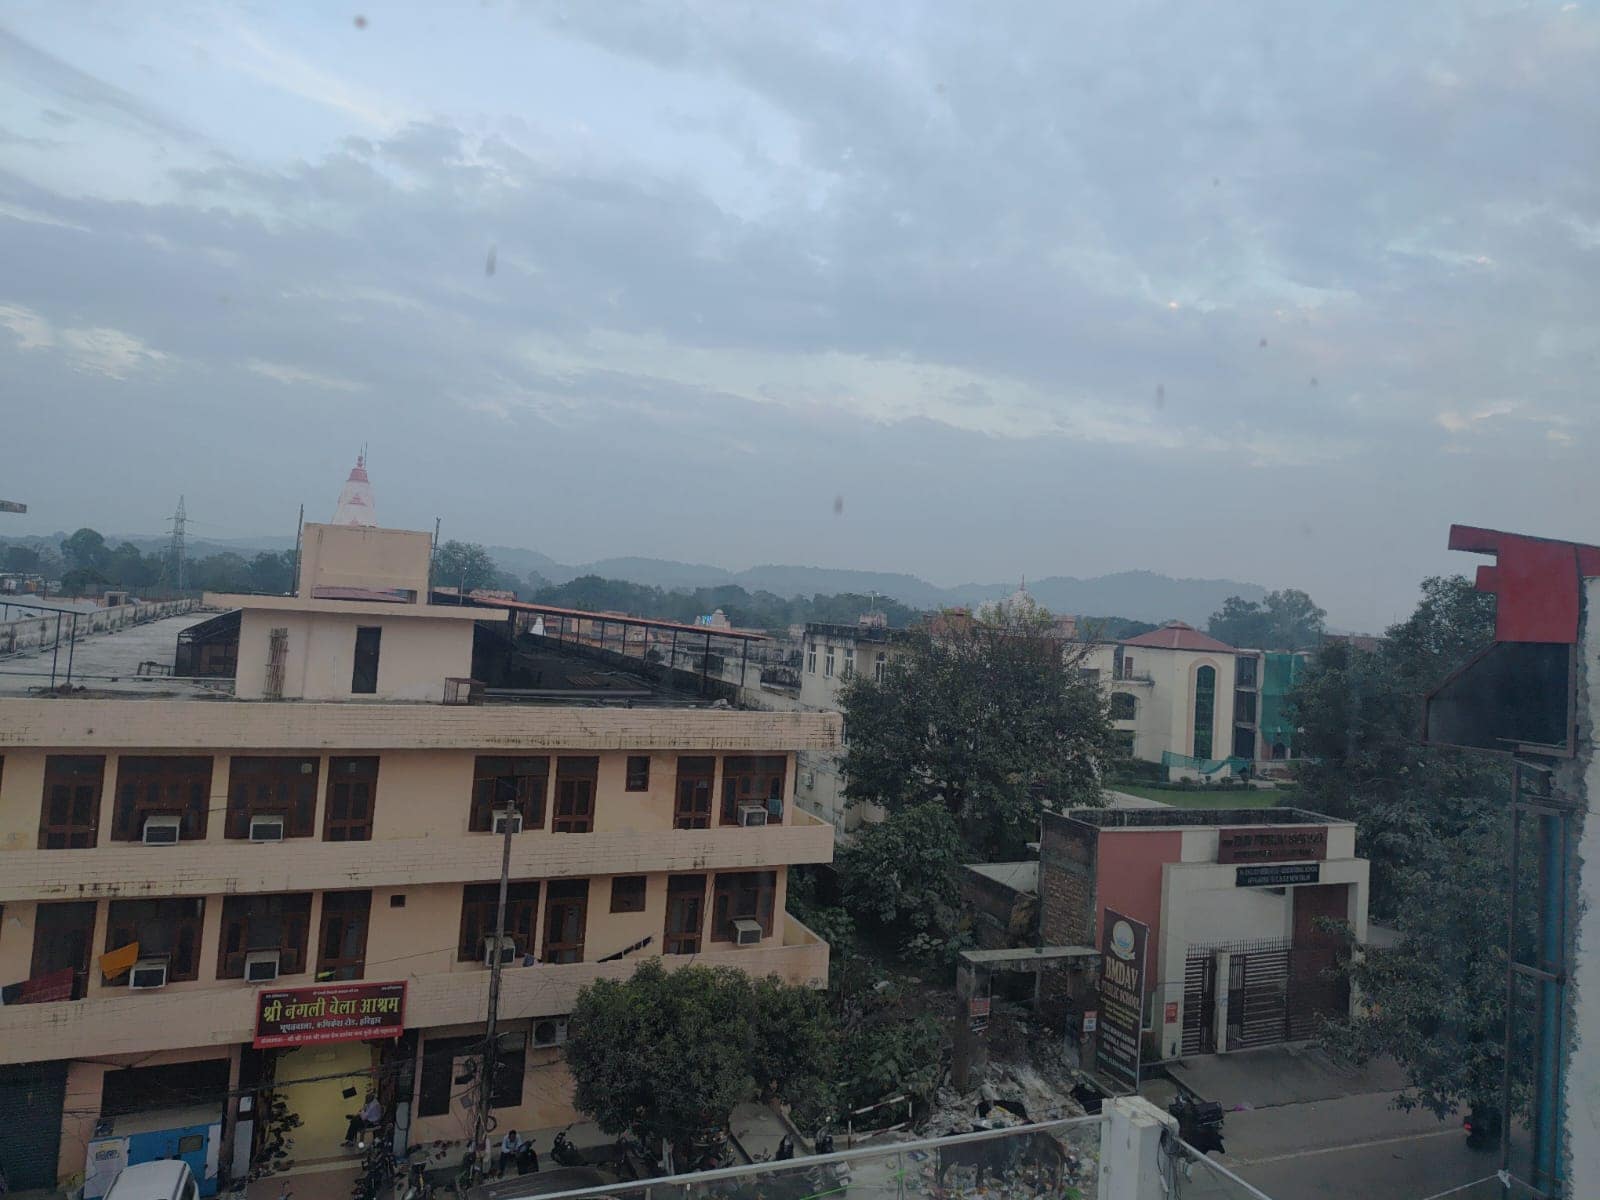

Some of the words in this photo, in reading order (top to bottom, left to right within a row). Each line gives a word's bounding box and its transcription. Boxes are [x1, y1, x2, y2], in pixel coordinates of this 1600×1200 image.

[1105, 956, 1138, 992] BMDAV
[263, 1000, 282, 1022] श्री
[285, 996, 326, 1019] नंगली
[360, 996, 400, 1014] आश्रम
